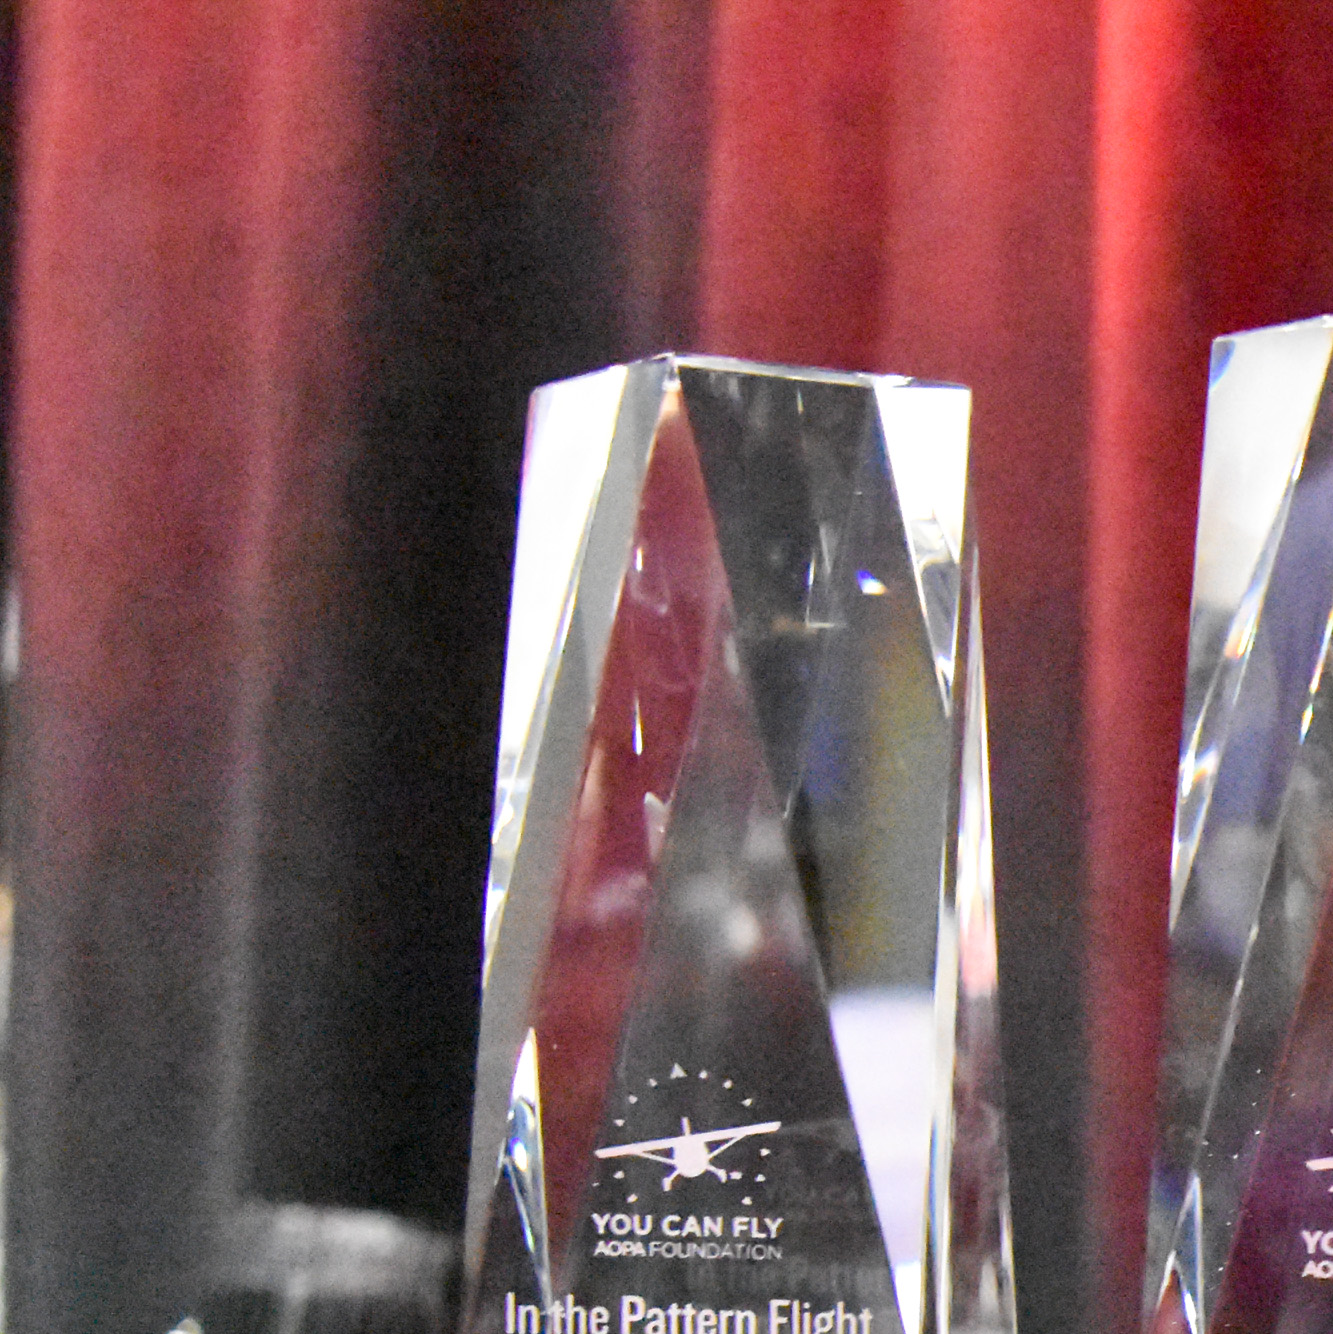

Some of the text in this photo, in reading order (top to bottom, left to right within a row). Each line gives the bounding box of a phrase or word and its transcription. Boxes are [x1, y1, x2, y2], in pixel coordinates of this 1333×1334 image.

[592, 1213, 784, 1239] YOU CAN FLY
[593, 1241, 783, 1260] AOPA FOUNDATION
[505, 1292, 540, 1334] In
